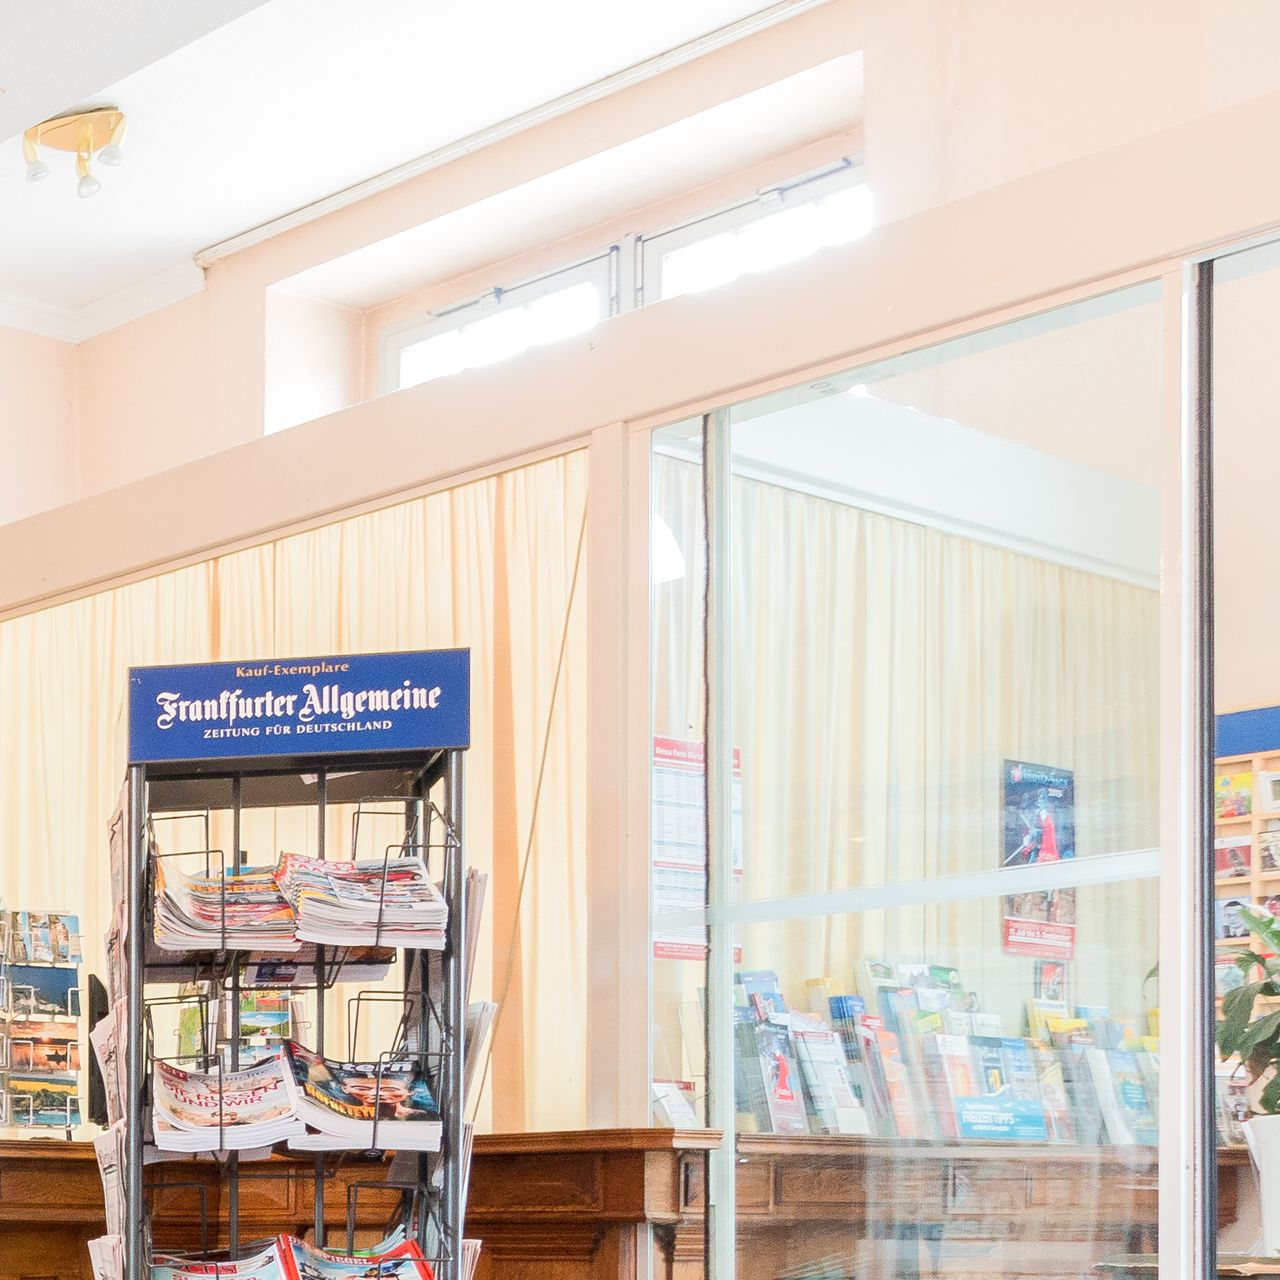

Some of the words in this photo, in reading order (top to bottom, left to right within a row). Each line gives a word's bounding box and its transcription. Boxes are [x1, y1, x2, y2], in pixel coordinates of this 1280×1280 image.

[236, 662, 349, 679] Kauf-Exemplare
[156, 689, 296, 730] Frankfurter
[299, 679, 442, 722] Allgemeine
[203, 726, 260, 739] ZEITUNG
[265, 724, 291, 736] FÜR
[296, 719, 393, 734] DEUTSCHLAND
[175, 1094, 218, 1108] UND
[223, 1095, 263, 1107] WIR
[196, 1083, 279, 1101] RUSSEN
